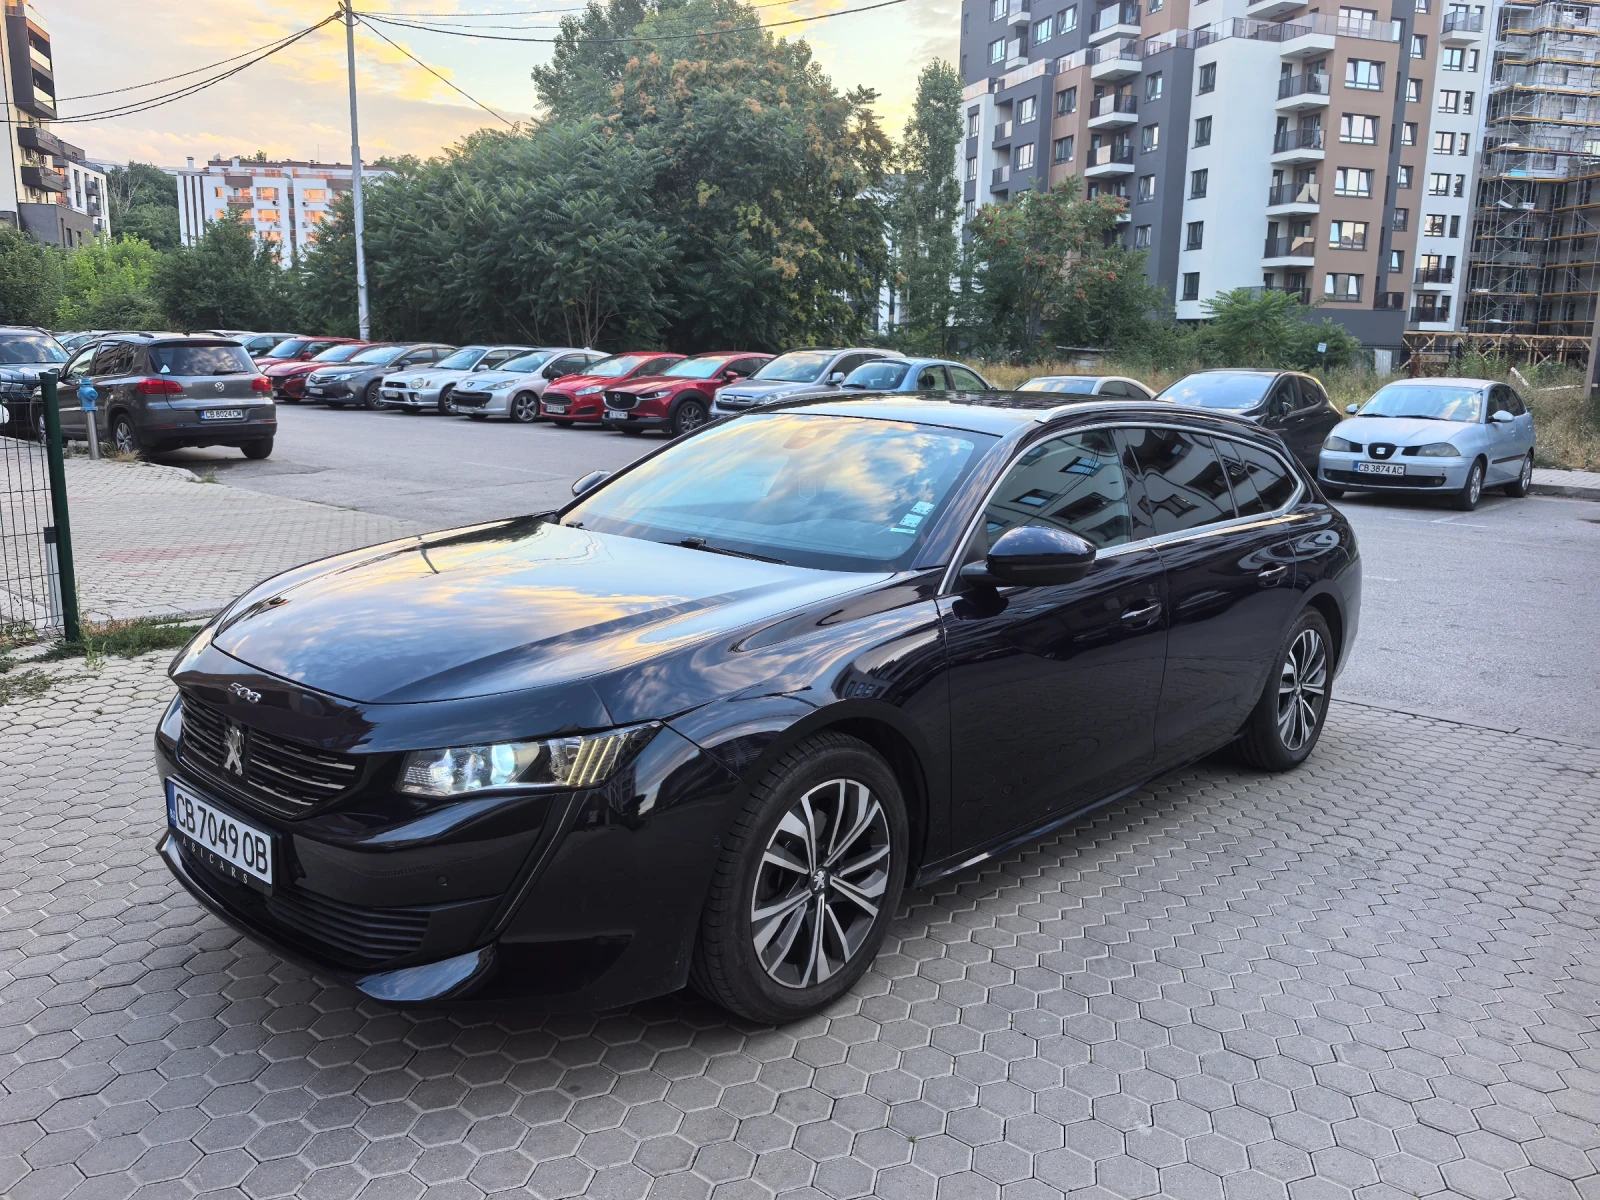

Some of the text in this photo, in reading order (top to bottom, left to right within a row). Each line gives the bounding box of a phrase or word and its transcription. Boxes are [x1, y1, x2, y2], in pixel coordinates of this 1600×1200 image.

[1358, 463, 1403, 475] CB 3874 AC
[227, 682, 262, 704] 508
[176, 793, 196, 834] CB
[197, 805, 239, 859] 7049
